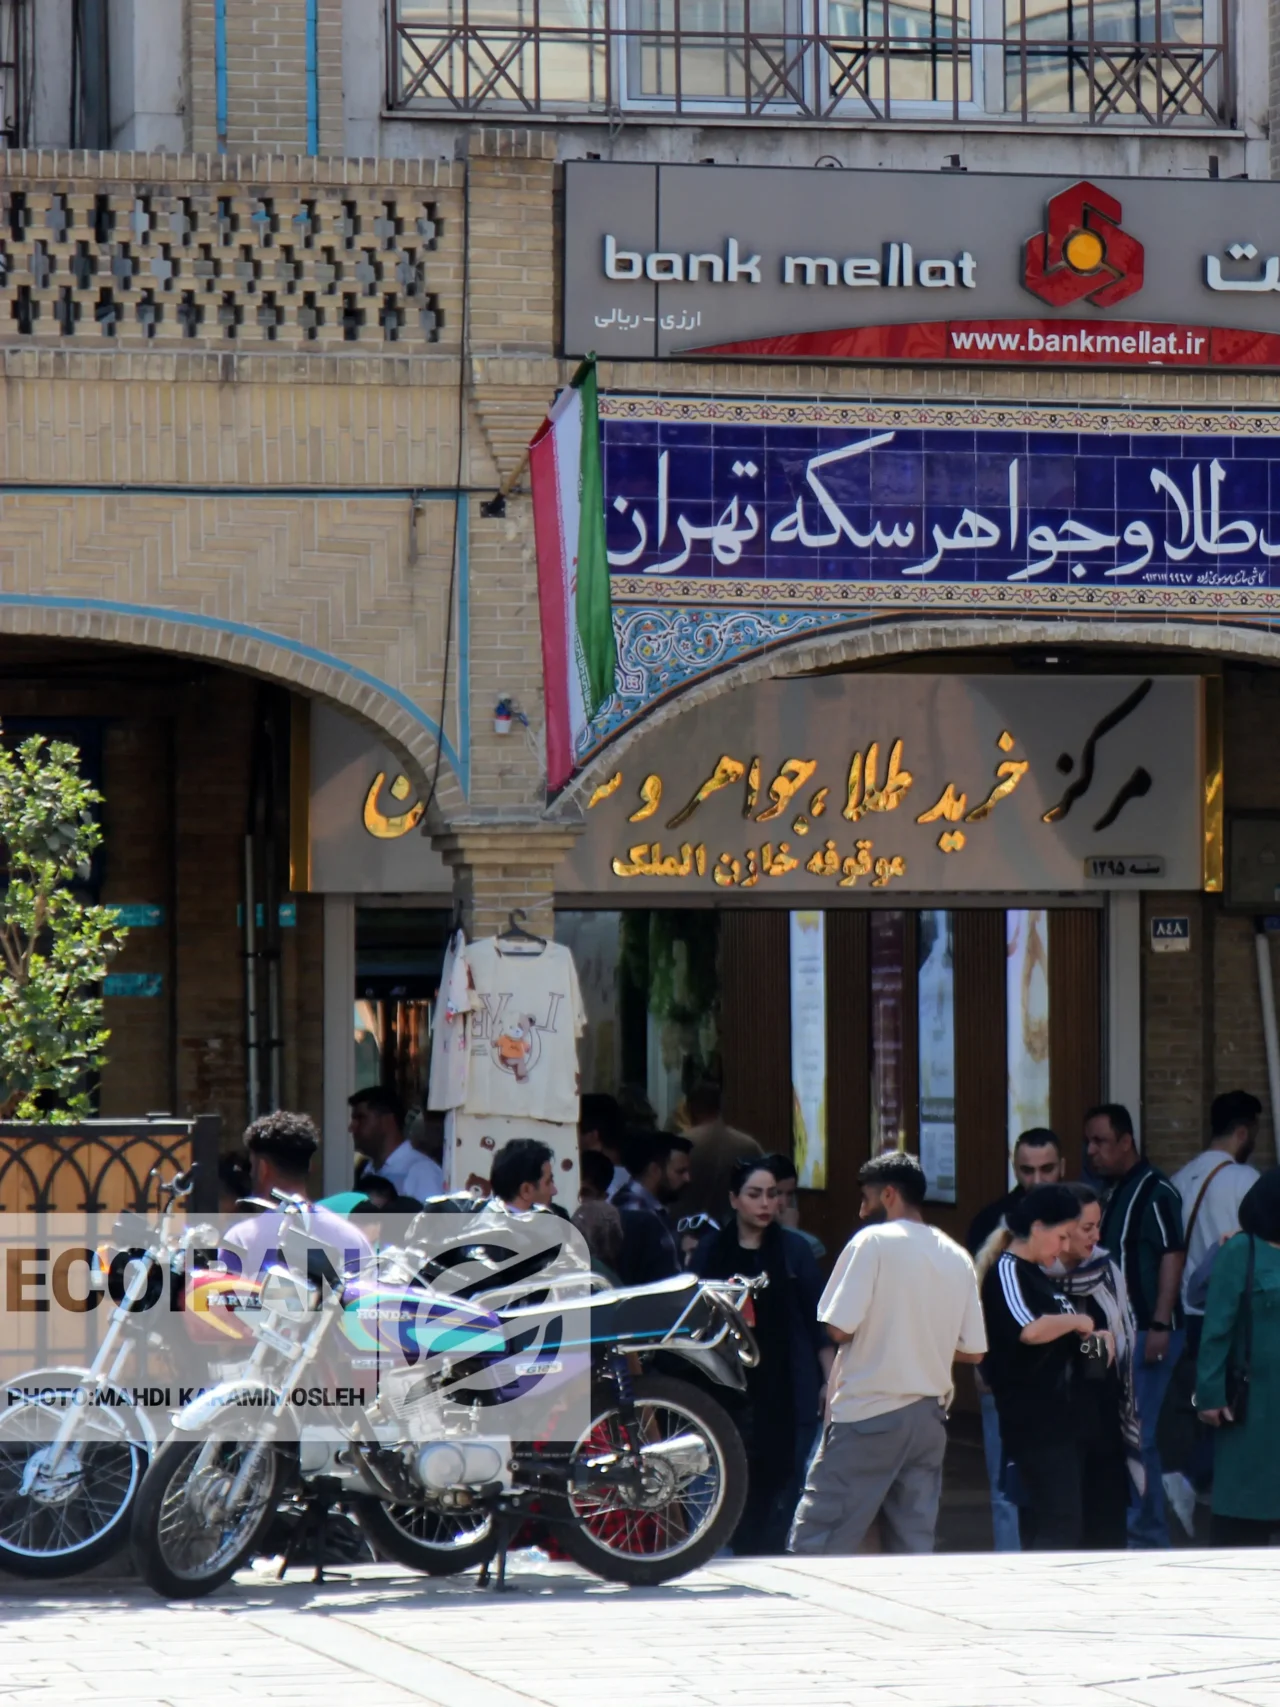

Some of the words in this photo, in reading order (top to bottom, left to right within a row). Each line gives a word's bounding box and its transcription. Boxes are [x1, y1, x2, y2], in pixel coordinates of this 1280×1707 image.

[602, 233, 762, 285] bank
[783, 241, 978, 289] mellat
[594, 307, 640, 331] ریالی
[660, 309, 702, 331] ارزی
[951, 329, 1206, 356] www.bankmellat.ir
[606, 449, 760, 574] تهران
[770, 430, 915, 549] سکه
[1150, 458, 1259, 562] طلا
[901, 458, 1121, 582] جواهر
[1104, 518, 1154, 577] و
[1041, 677, 1154, 832] مرکز
[665, 754, 817, 836] جواهر
[916, 730, 1030, 854] خرید
[612, 841, 706, 878] الملک
[714, 842, 799, 887] خازن
[805, 840, 906, 887] موقوفه
[356, 1309, 413, 1321] HONDA
